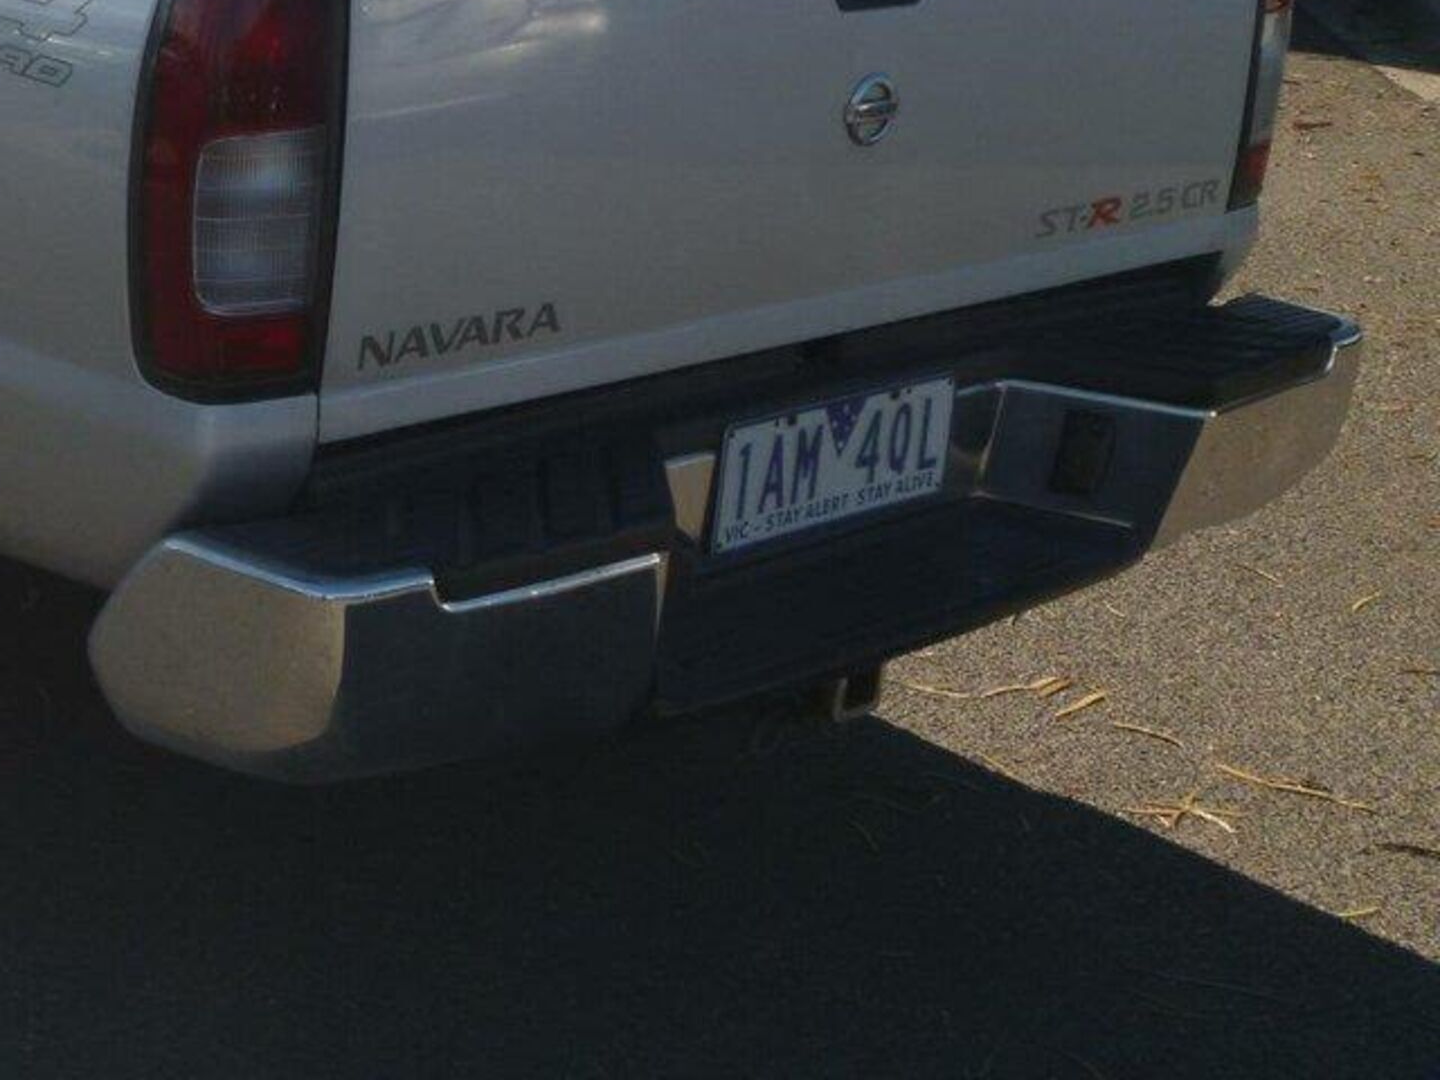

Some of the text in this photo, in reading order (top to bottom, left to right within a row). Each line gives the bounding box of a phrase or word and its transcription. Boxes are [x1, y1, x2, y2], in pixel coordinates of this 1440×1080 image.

[357, 301, 561, 370] NAVARA
[735, 423, 824, 520] 1AM
[766, 506, 800, 532] STAY
[805, 493, 849, 519] ALERT
[857, 481, 892, 506] STAY
